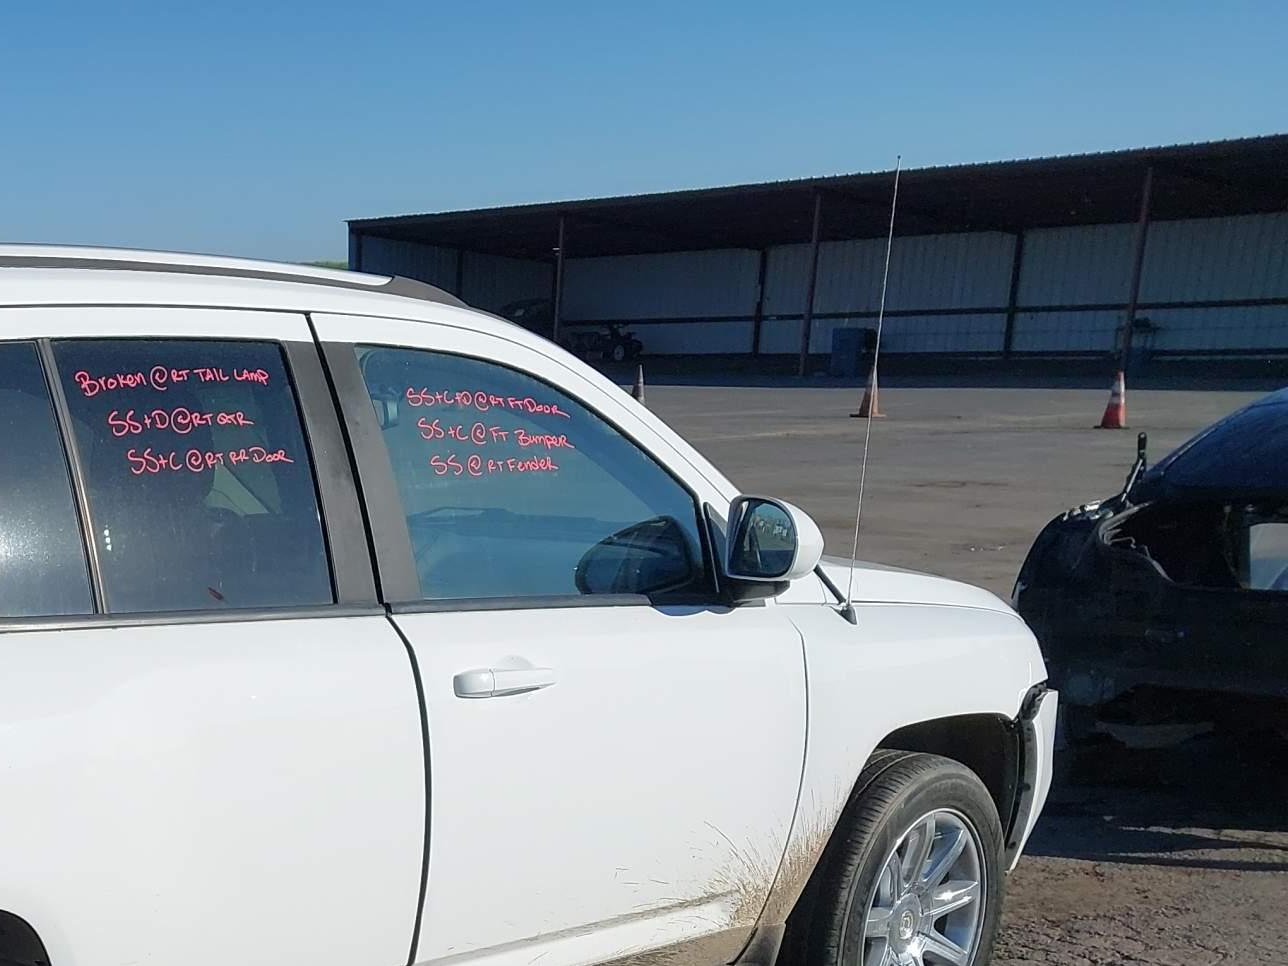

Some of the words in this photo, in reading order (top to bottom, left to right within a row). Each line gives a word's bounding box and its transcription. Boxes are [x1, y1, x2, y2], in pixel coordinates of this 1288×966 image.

[75, 371, 147, 396] Broken
[149, 366, 168, 391] @
[170, 369, 189, 381] RT
[193, 368, 229, 382] TAIL
[489, 426, 510, 443] FT
[430, 454, 463, 475] SS
[467, 455, 482, 475] @
